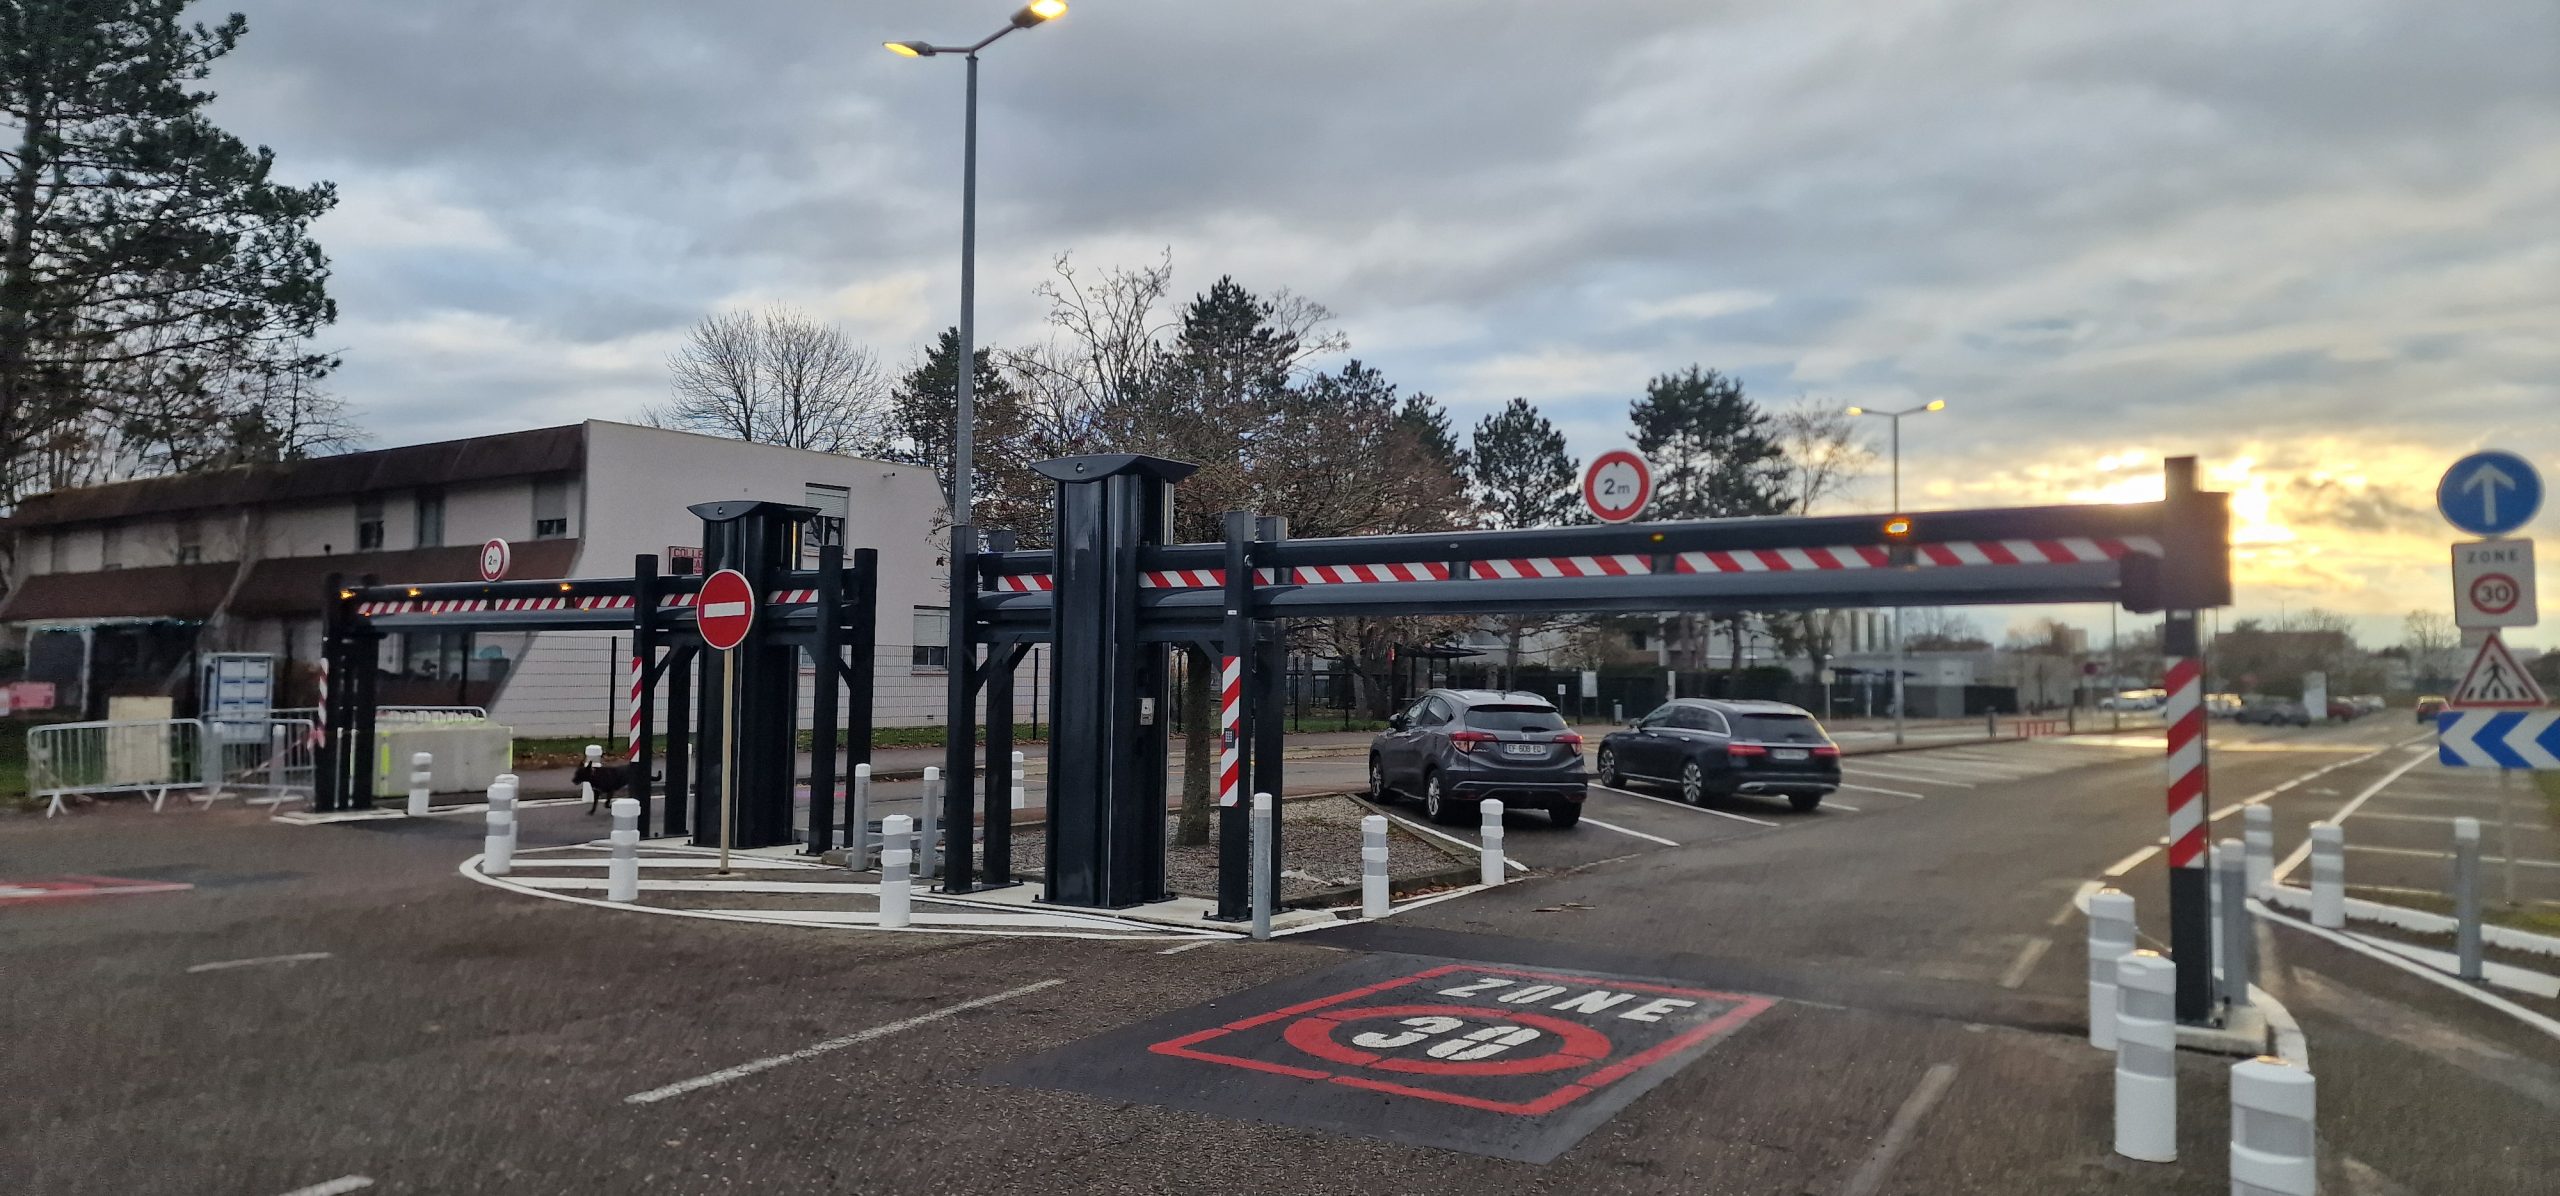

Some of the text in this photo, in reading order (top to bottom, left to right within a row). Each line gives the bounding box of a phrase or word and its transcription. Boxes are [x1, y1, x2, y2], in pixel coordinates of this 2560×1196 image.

[1603, 478, 1631, 495] 2m
[673, 548, 704, 557] COLLE
[2467, 549, 2519, 564] ZONE
[2480, 585, 2510, 602] 30
[1438, 977, 1697, 1023] ZONE
[1352, 1016, 1541, 1061] 30
